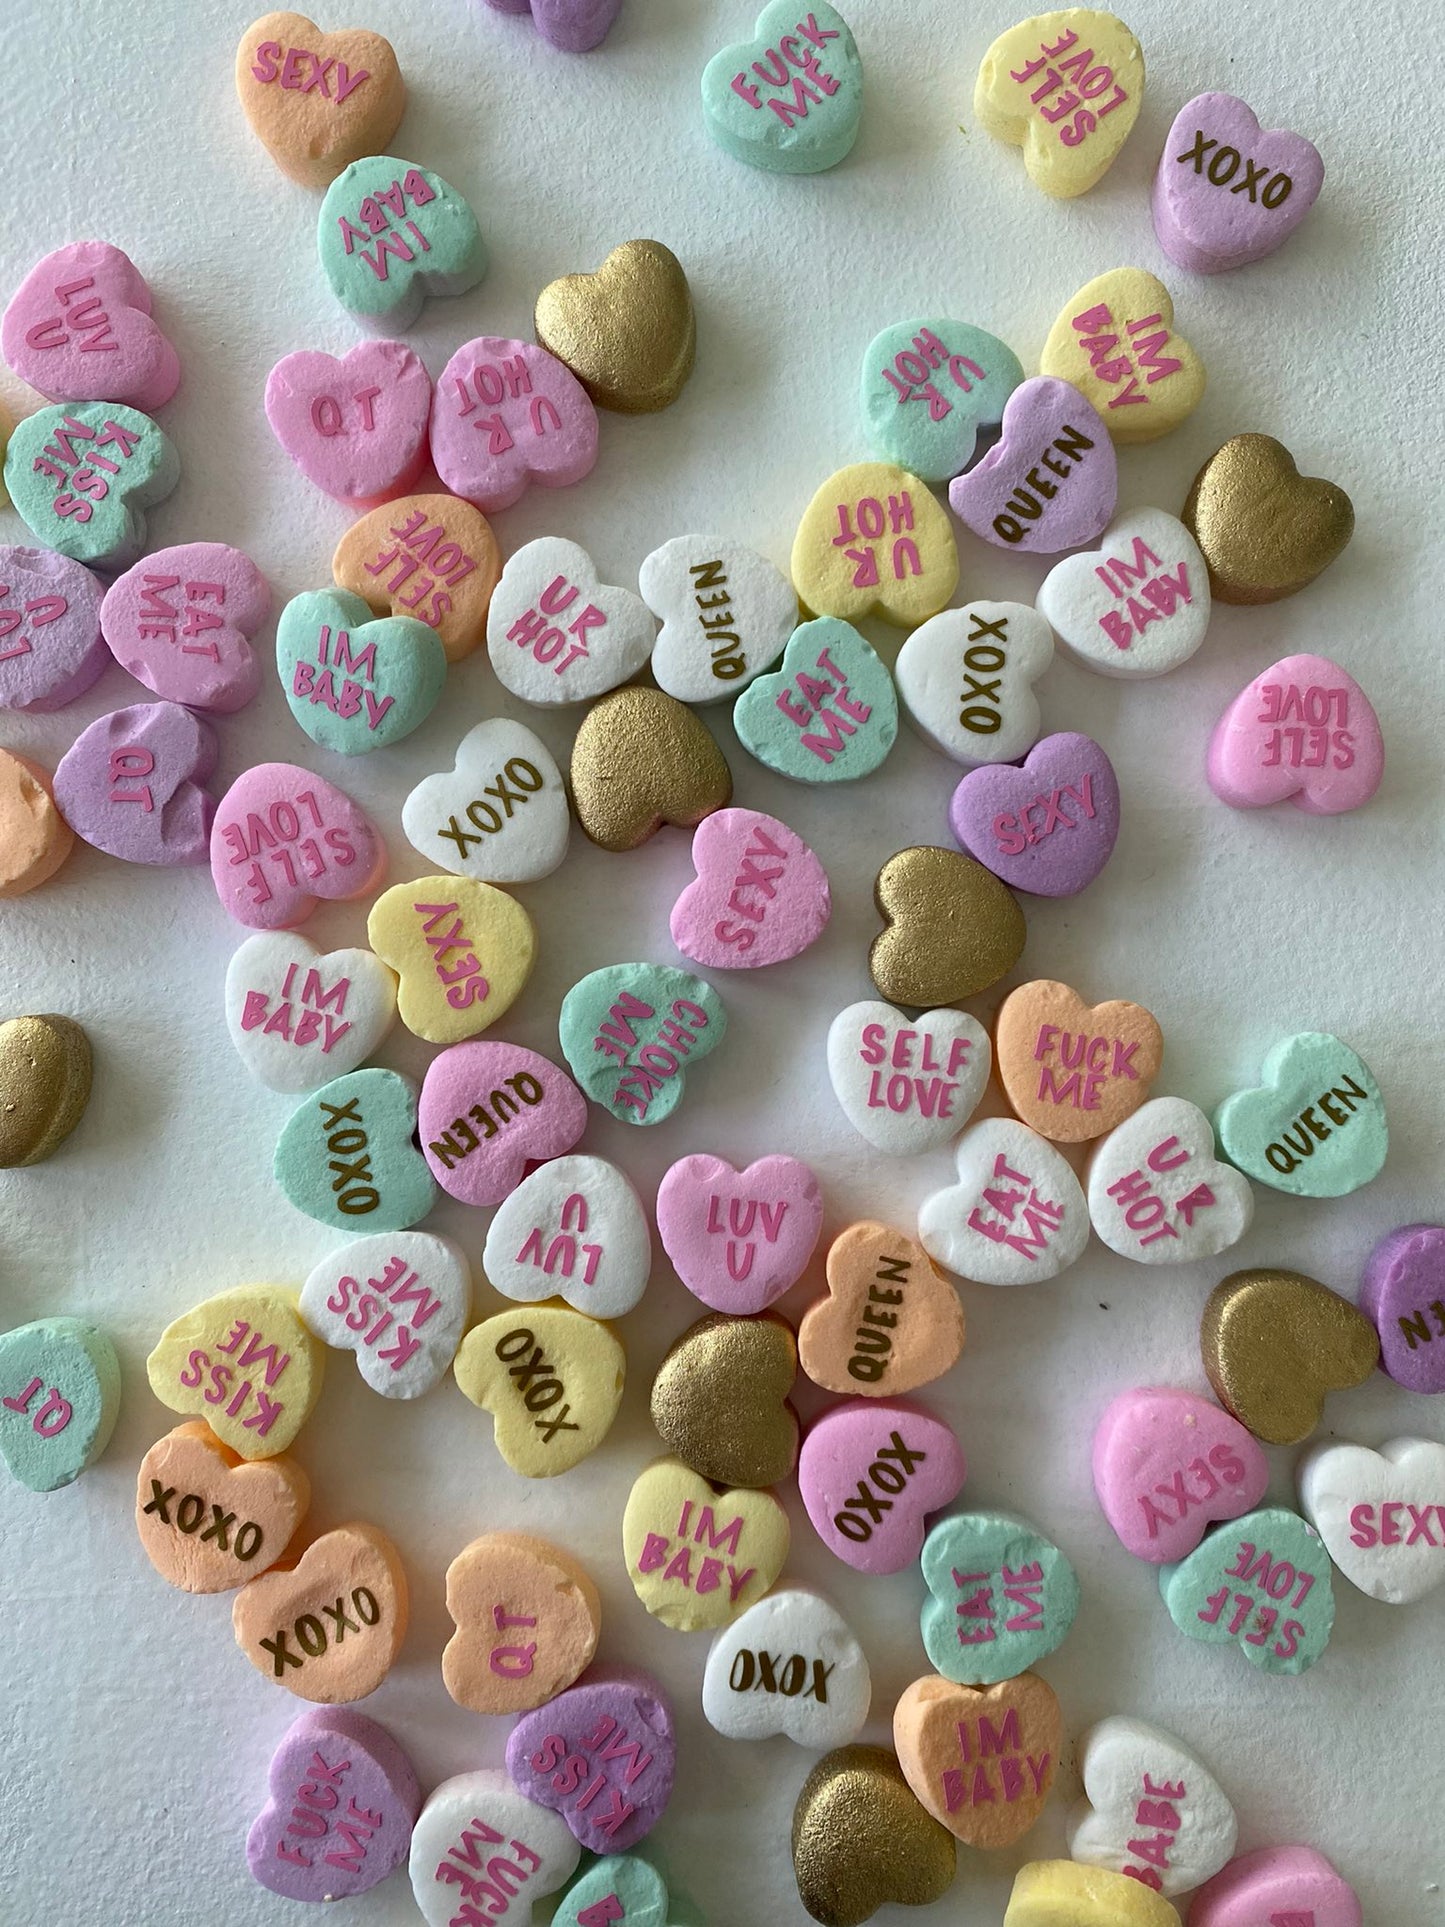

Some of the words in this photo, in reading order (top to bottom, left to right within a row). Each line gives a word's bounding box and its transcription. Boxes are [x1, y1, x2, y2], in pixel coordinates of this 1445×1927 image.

[252, 43, 368, 104] SEXY
[731, 13, 840, 110] FUCK
[767, 59, 842, 128] ME
[1041, 28, 1129, 119] LOVE
[1010, 56, 1096, 147] SELF
[1176, 130, 1293, 210] XOXO
[339, 170, 436, 254] BABY
[358, 220, 432, 282] IM
[26, 317, 71, 351] U
[55, 277, 118, 353] LUV
[1126, 313, 1182, 384] IM
[455, 354, 533, 417] HOT
[882, 328, 950, 405] HOT
[948, 354, 985, 392] U
[1072, 303, 1149, 409] BABY
[312, 387, 382, 437] QT
[473, 413, 515, 455] R
[530, 396, 562, 436] U
[912, 384, 952, 421] R
[33, 416, 96, 489] ME
[53, 420, 140, 523] KISS
[992, 425, 1095, 544] QUEEN
[390, 510, 476, 587] LOVE
[832, 491, 915, 548] HOT
[364, 546, 452, 628] SELF
[844, 547, 877, 588] R
[893, 538, 925, 581] U
[1095, 536, 1163, 598] IM
[137, 575, 182, 644] ME
[182, 581, 227, 664] EAT
[506, 608, 590, 676] HOT
[540, 575, 581, 615] U
[568, 603, 608, 647] R
[689, 560, 747, 680] QUEEN
[1099, 562, 1194, 650] BABY
[317, 625, 379, 683] IM
[776, 648, 847, 727] EAT
[960, 613, 1009, 735] XOXO
[294, 660, 396, 731] BABY
[800, 686, 873, 764] ME
[1258, 685, 1348, 728] LOVE
[109, 746, 154, 813] QT
[1262, 728, 1355, 770] SELF
[222, 790, 323, 866] LOVE
[437, 757, 545, 860] XOXO
[992, 773, 1096, 856] SEXY
[247, 827, 356, 903] SELF
[714, 826, 788, 951] SEXY
[281, 963, 351, 1017] IM
[414, 902, 489, 1009] SEXY
[241, 990, 355, 1054] BABY
[593, 991, 656, 1067] ME
[860, 1024, 972, 1078] SELF
[1035, 1024, 1140, 1080] FUCK
[615, 1000, 709, 1120] CHOKE
[867, 1070, 961, 1119] LOVE
[1038, 1066, 1108, 1110] ME
[319, 1097, 381, 1215] XOXO
[428, 1072, 545, 1170] QUEEN
[1265, 1074, 1369, 1175] QUEEN
[560, 1193, 589, 1234] U
[967, 1153, 1033, 1243] EAT
[1106, 1170, 1180, 1248] HOT
[1148, 1135, 1193, 1173] U
[1175, 1183, 1216, 1226] R
[707, 1195, 790, 1243] LUV
[1003, 1186, 1066, 1262] ME
[367, 1256, 444, 1330] ME
[515, 1227, 604, 1286] LUV
[727, 1241, 756, 1282] U
[216, 1320, 292, 1387] ME
[327, 1276, 424, 1372] KISS
[847, 1255, 912, 1383] QUEEN
[3, 1377, 72, 1437] QT
[180, 1350, 285, 1437] KISS
[495, 1328, 581, 1444] XOXO
[142, 1478, 263, 1562] XOXO
[1138, 1444, 1245, 1539] SEXY
[677, 1501, 745, 1557] IM
[637, 1533, 756, 1600] BABY
[999, 1561, 1045, 1632] ME
[1224, 1542, 1315, 1609] LOVE
[259, 1586, 380, 1677] XOXO
[490, 1605, 538, 1679] QT
[952, 1568, 998, 1646] EAT
[1198, 1586, 1305, 1658] SELF
[579, 1714, 653, 1785] ME
[957, 1708, 1020, 1762] IM
[278, 1751, 352, 1868] FUCK
[530, 1734, 635, 1837] KISS
[942, 1753, 1049, 1813] BABY
[325, 1796, 383, 1873] ME
[436, 1818, 504, 1896] ME
